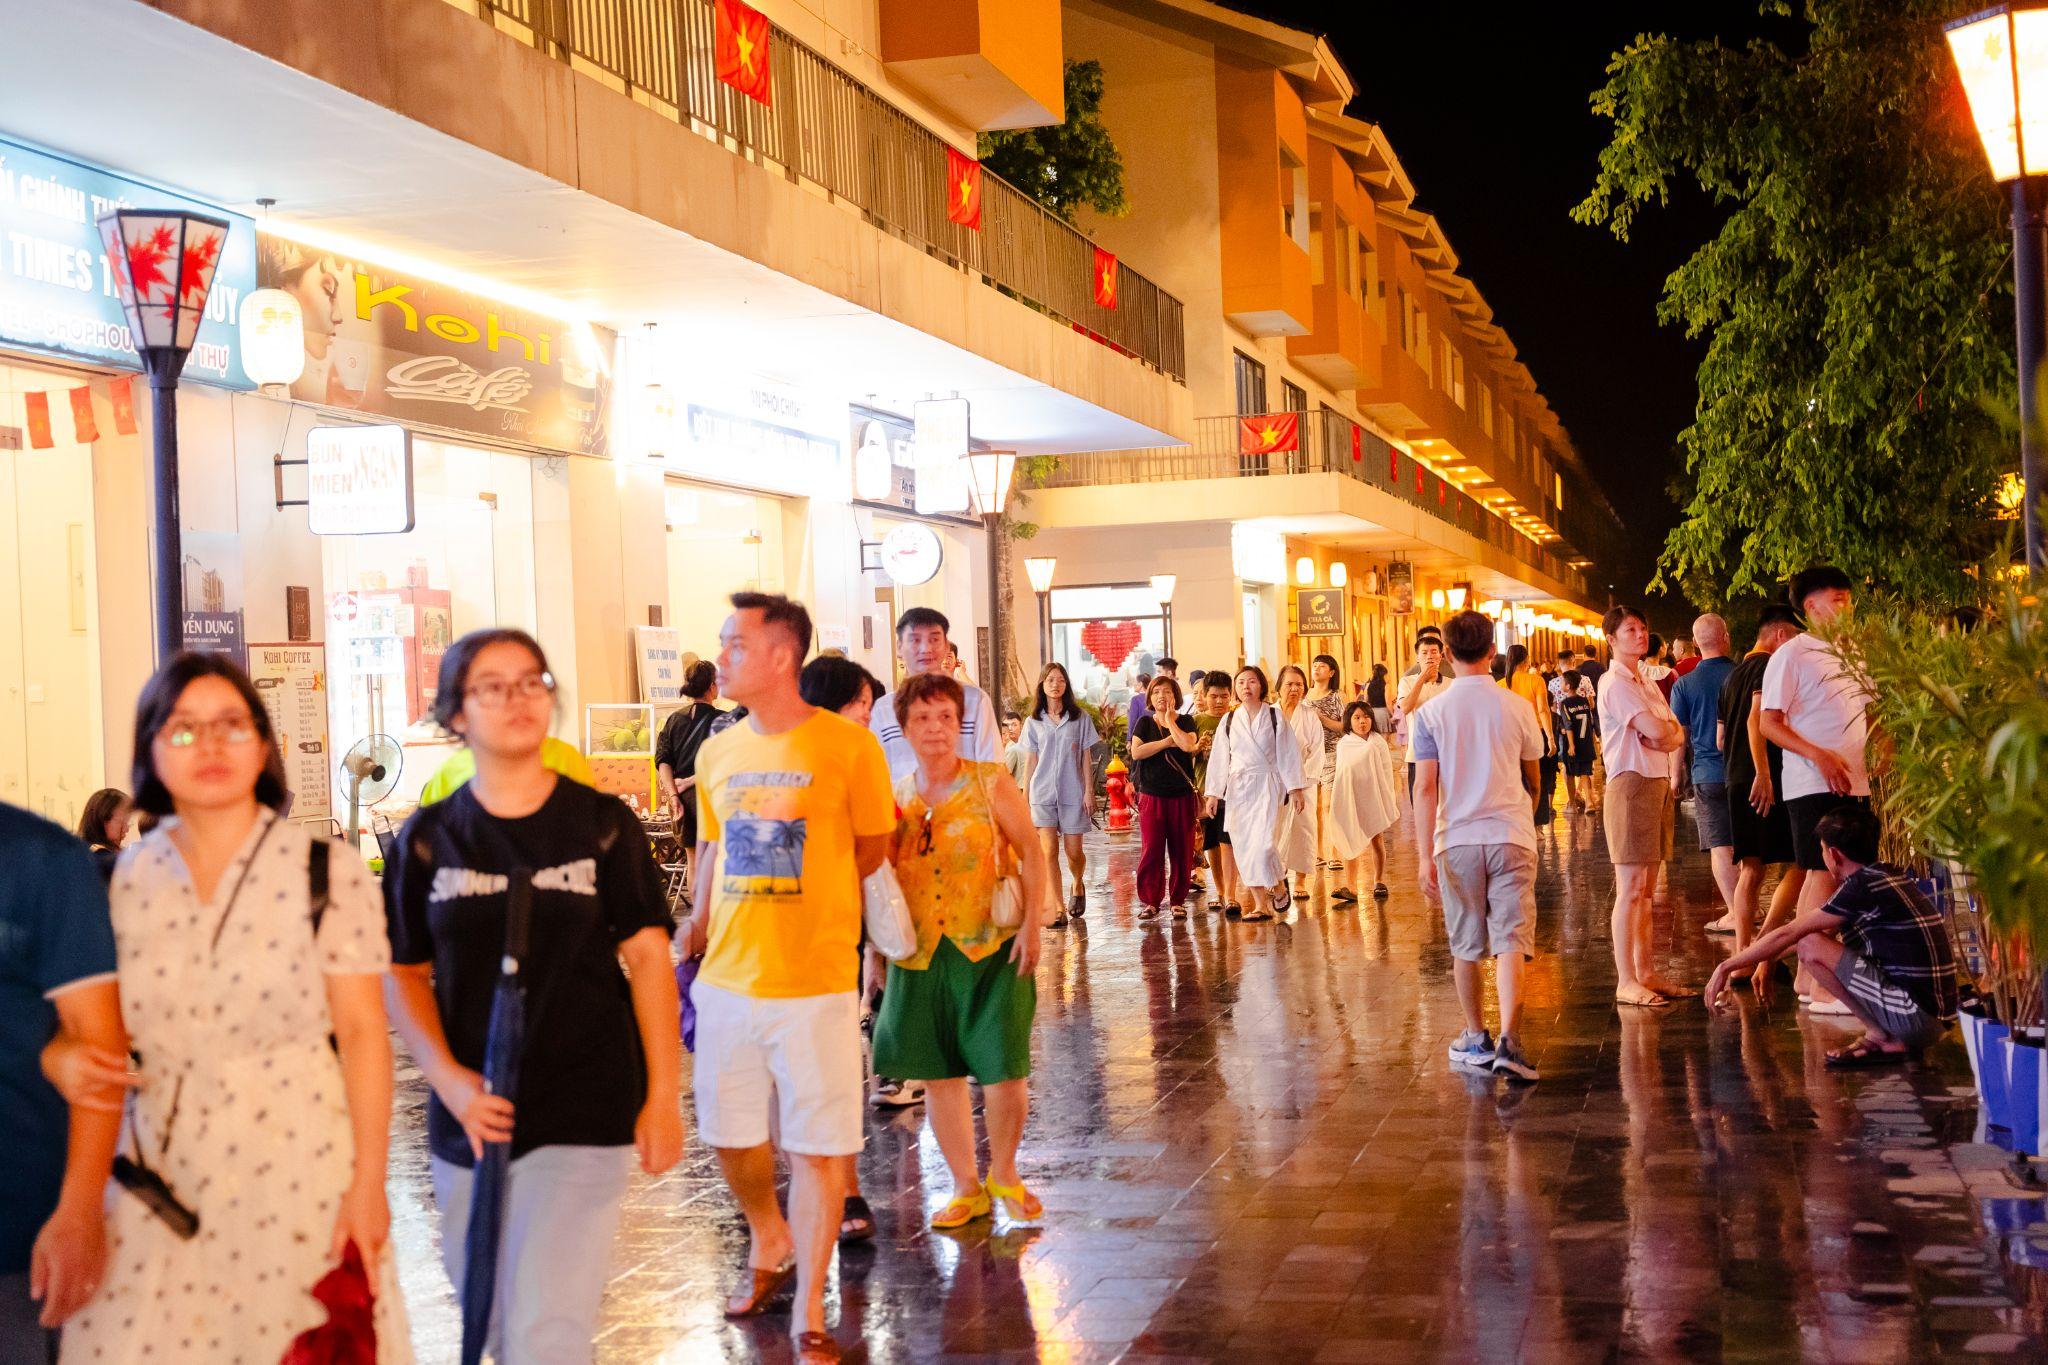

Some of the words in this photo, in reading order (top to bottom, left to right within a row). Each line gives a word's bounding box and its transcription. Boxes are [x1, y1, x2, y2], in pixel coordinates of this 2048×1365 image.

[8, 231, 93, 292] TIMES
[47, 313, 134, 352] SHOPHOU
[355, 273, 552, 366] Kohi
[182, 613, 202, 633] YỂN
[205, 620, 234, 637] DỤNG
[263, 651, 281, 664] KOHI
[283, 651, 311, 664] COFFEE
[1575, 713, 1587, 739] 7
